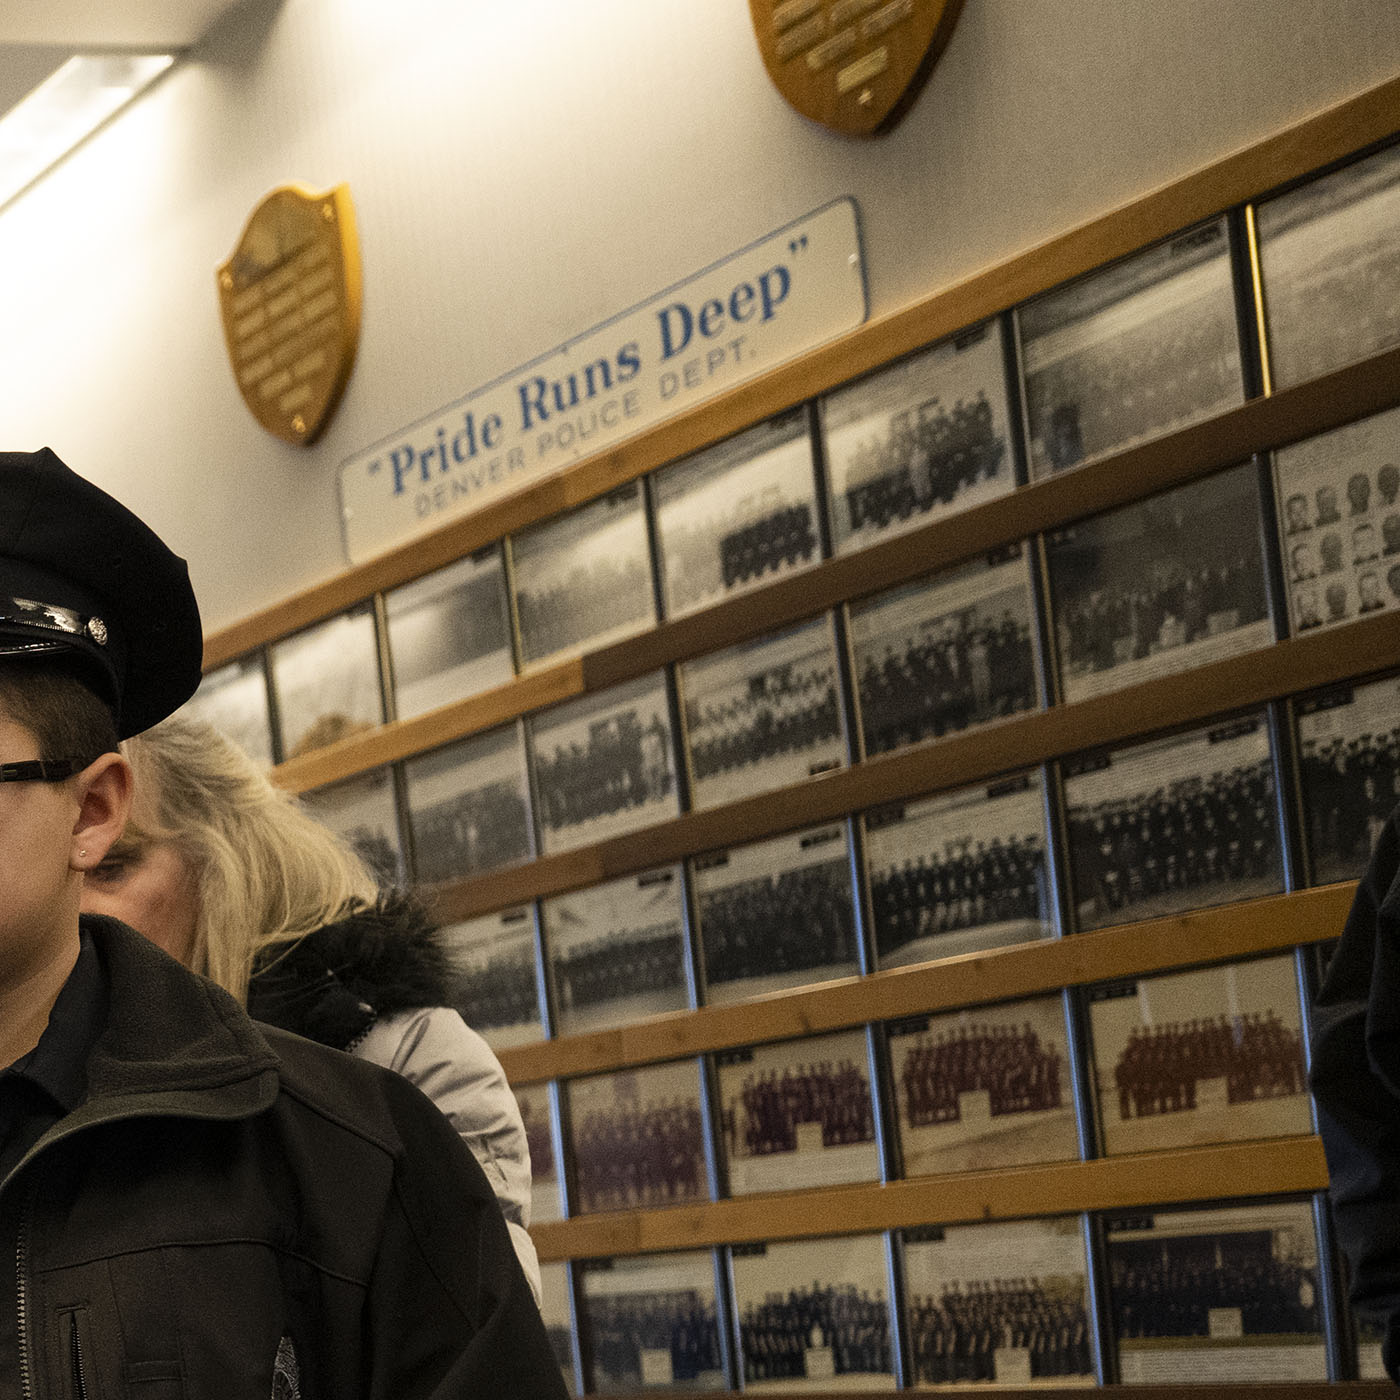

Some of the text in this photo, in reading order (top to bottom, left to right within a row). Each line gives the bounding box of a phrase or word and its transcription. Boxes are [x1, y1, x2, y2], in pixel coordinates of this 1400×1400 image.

[518, 341, 641, 430] Runs
[414, 447, 526, 517] DENVER
[537, 389, 640, 457] POLICE
